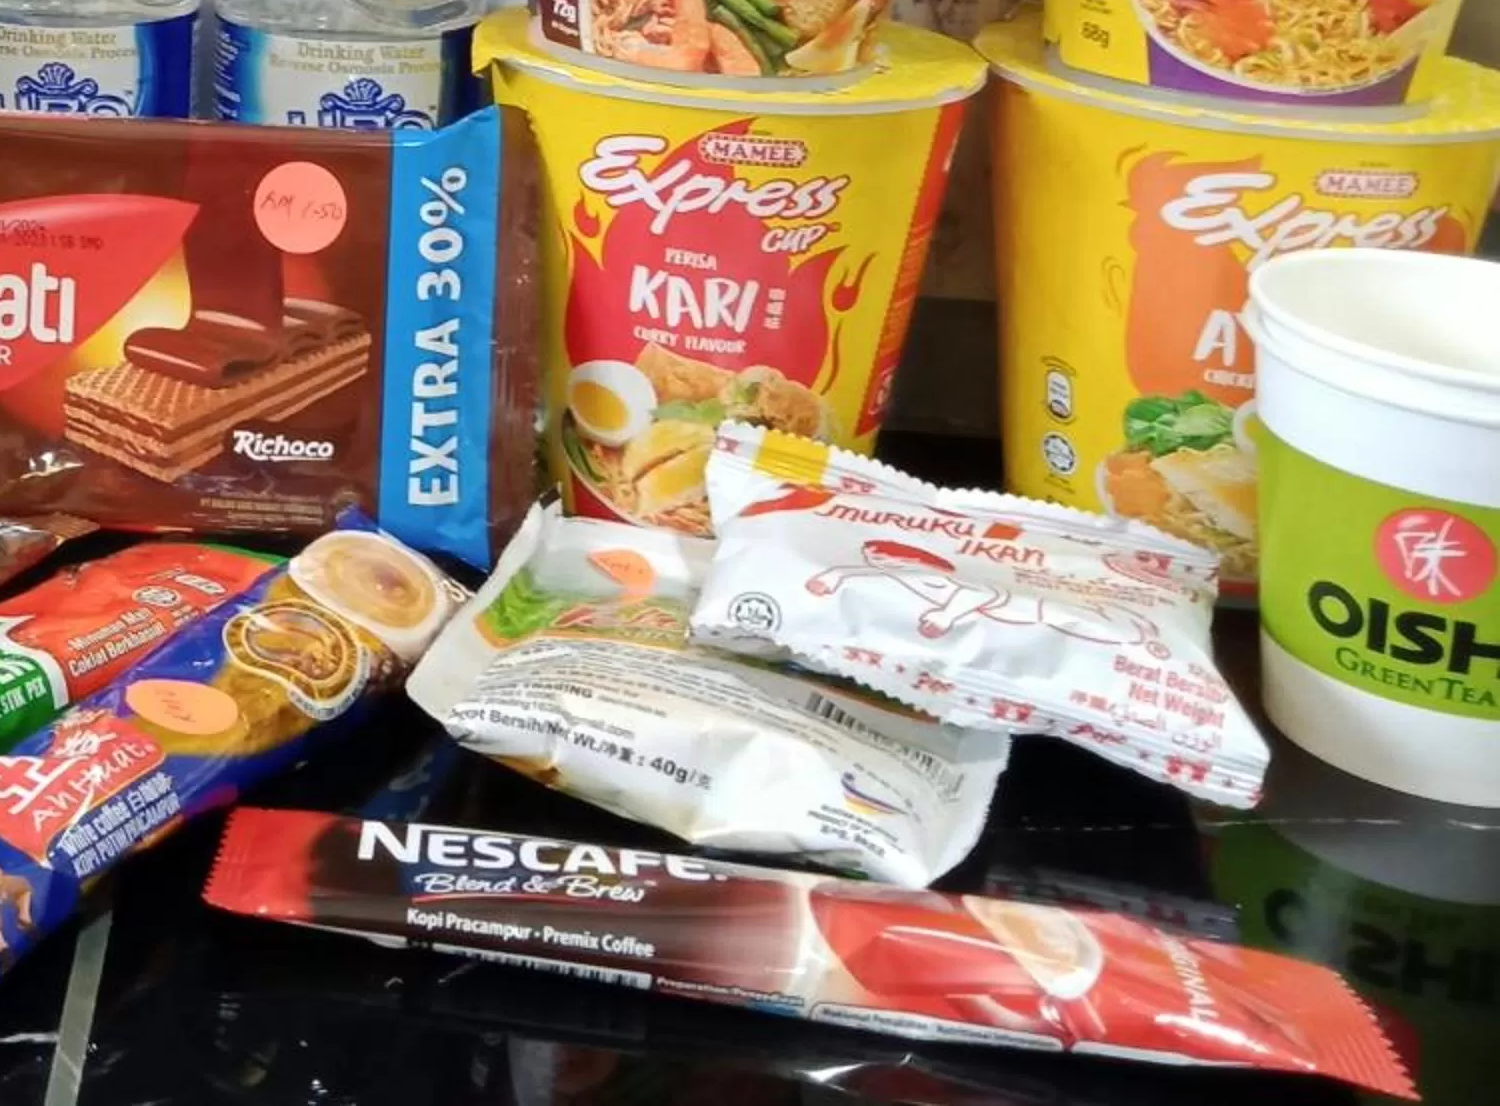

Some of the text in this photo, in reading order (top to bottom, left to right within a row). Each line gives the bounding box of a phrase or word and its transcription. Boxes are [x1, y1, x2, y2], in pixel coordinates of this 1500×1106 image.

[70, 31, 118, 45] Water
[297, 41, 376, 65] Drinking
[711, 140, 799, 162] MAMEE
[578, 134, 851, 236] Express
[1325, 174, 1412, 195] MAMEE
[1158, 170, 1451, 273] Express
[760, 225, 830, 254] CUP
[664, 247, 718, 272] PERISA
[628, 265, 760, 334] KARI
[407, 166, 469, 507] EXTRA 30%
[683, 332, 748, 355] FLAVOUR
[233, 429, 335, 461] Richoco
[412, 871, 646, 905] Blend & Brew
[407, 907, 656, 959] Kopi Pracampur Premix Coffee
